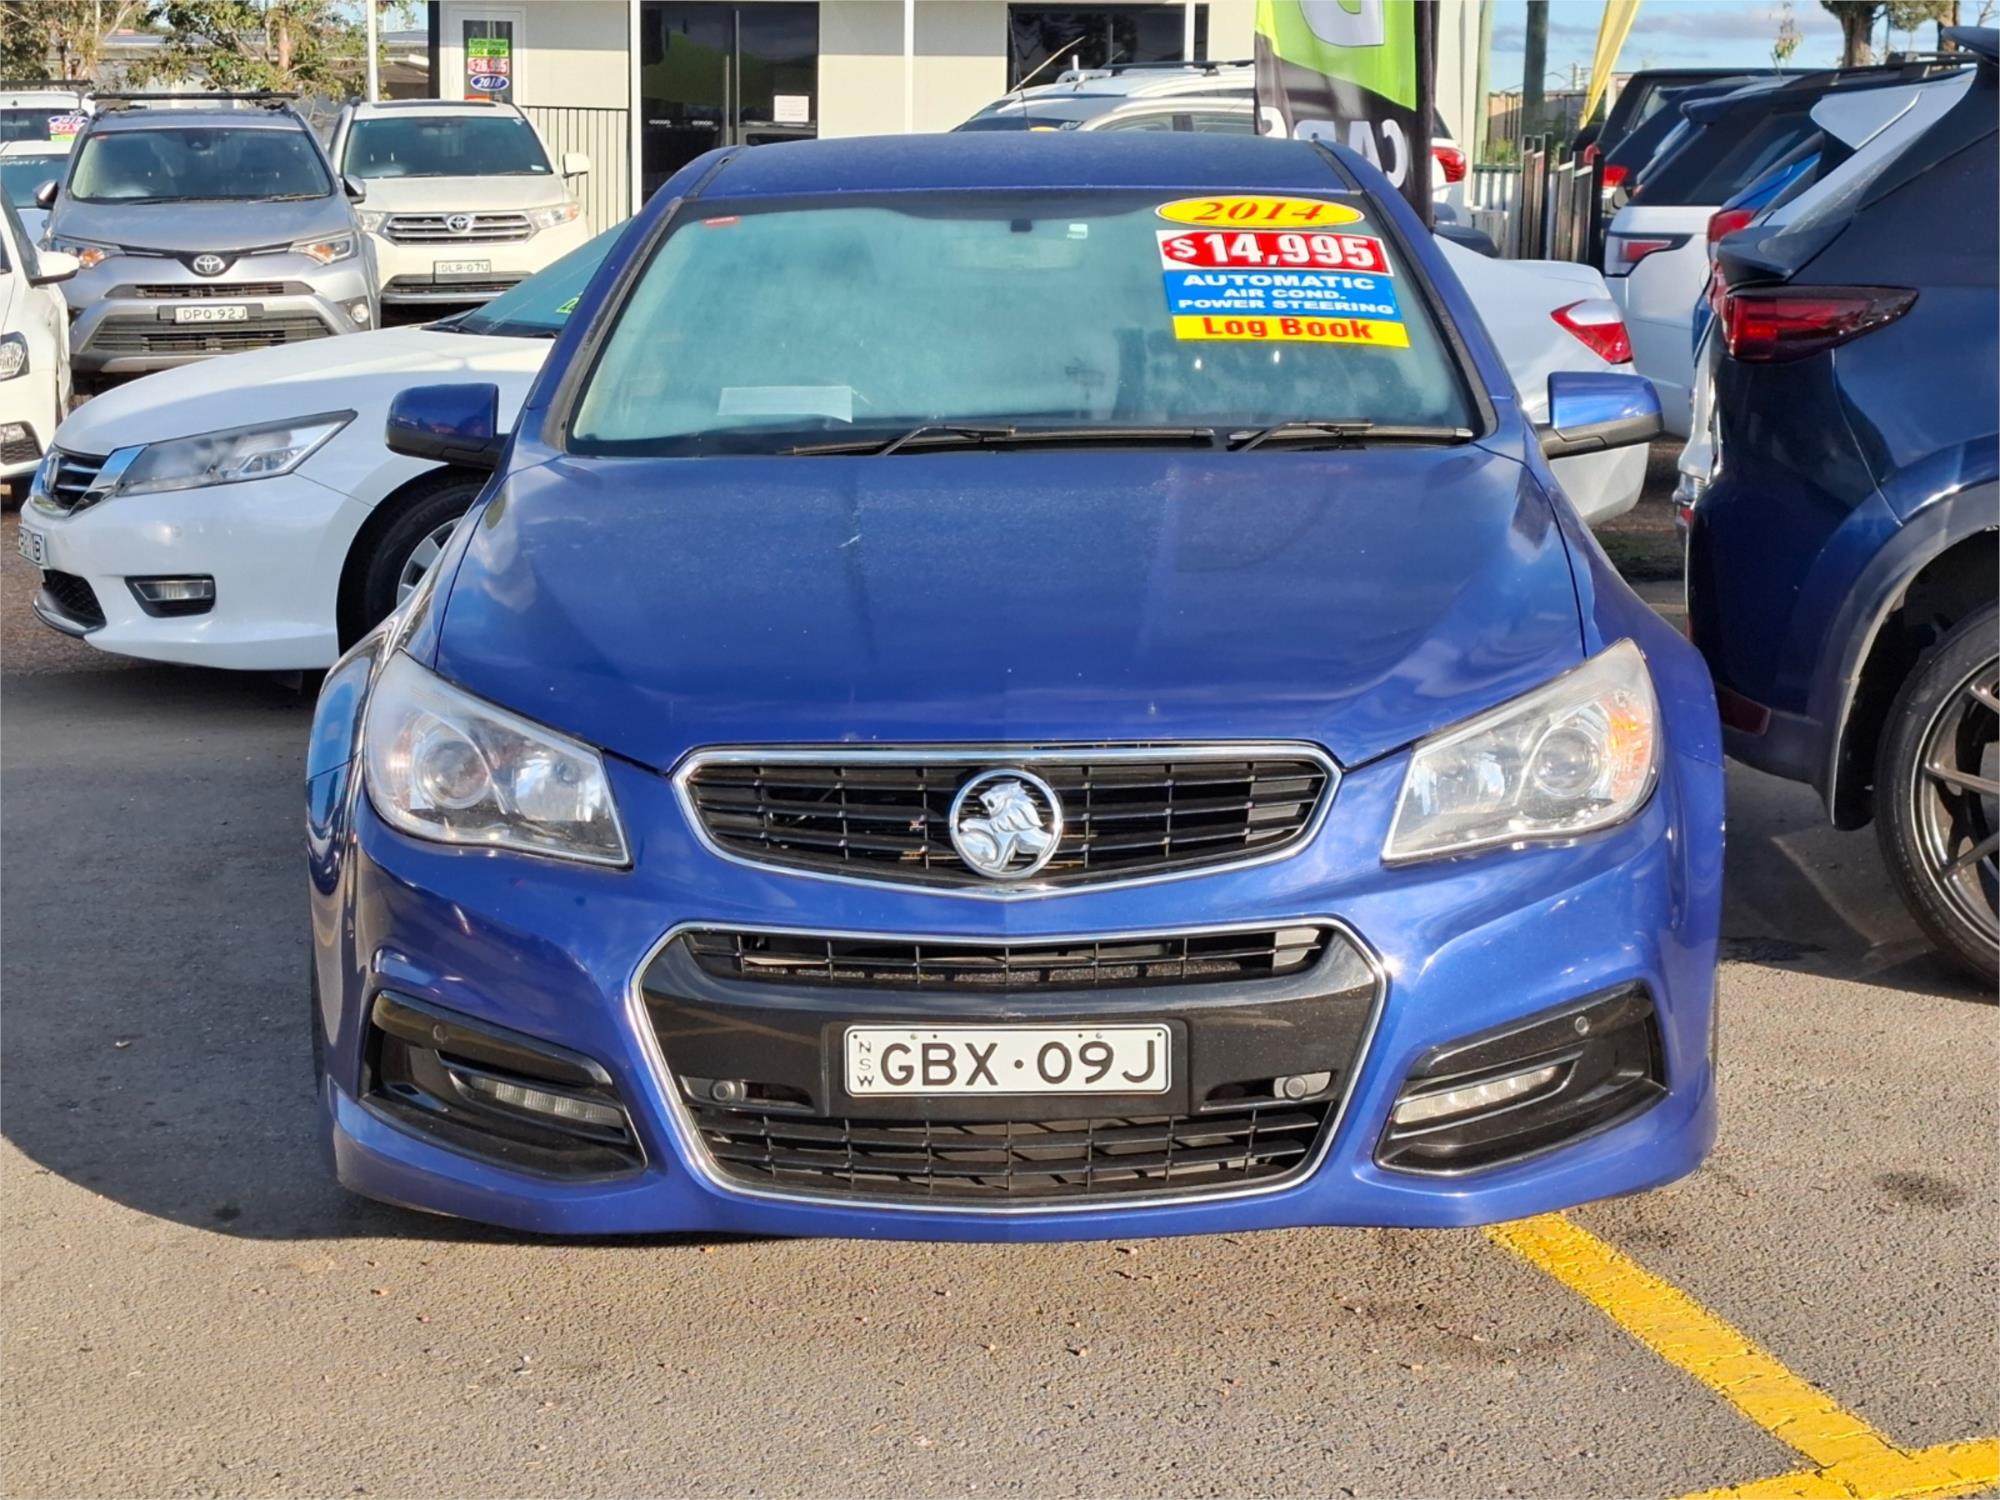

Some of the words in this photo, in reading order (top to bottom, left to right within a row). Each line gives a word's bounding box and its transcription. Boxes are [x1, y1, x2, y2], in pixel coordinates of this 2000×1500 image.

[1193, 202, 1325, 220] 2014
[1171, 233, 1375, 267] $14,995
[1183, 274, 1376, 290] AUTOMATIC
[1224, 288, 1265, 298] AIR
[1271, 288, 1347, 300] COND.
[1178, 299, 1266, 309] POWER
[1272, 299, 1395, 315] STEERING
[1203, 317, 1268, 337] Log
[1279, 318, 1373, 339] Book
